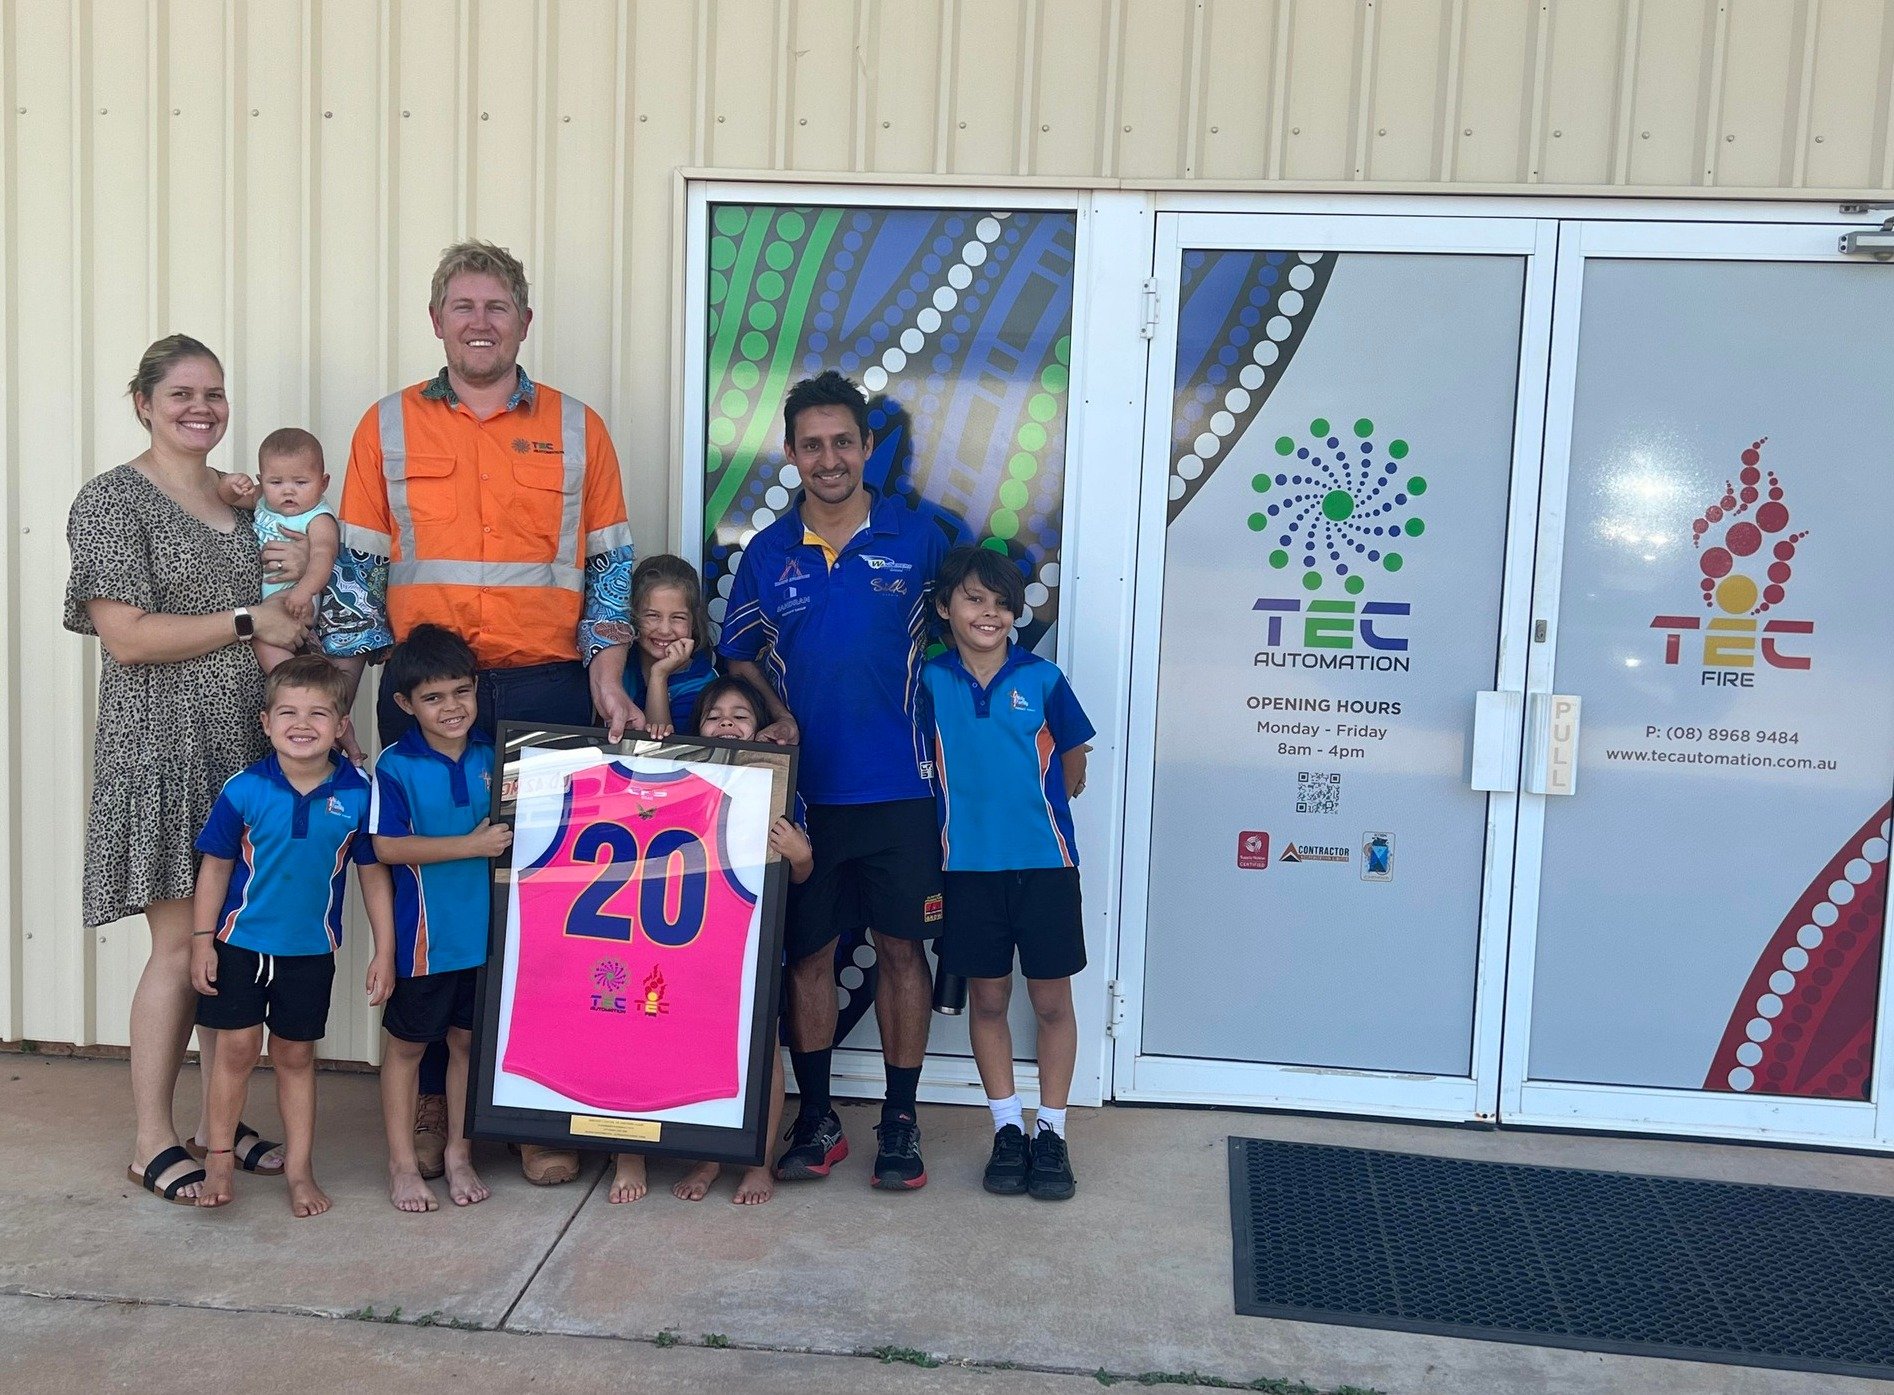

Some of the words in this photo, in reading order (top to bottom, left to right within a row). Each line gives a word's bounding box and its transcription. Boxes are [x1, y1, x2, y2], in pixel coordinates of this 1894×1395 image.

[1252, 598, 1411, 651] TEC
[1650, 615, 1814, 670] TEC
[1253, 652, 1410, 672] AUTOMATION
[1701, 671, 1755, 687] FIRE
[1246, 696, 1330, 713] OPENING
[1337, 700, 1402, 715] HOURS
[1257, 721, 1320, 738] Monday
[1337, 724, 1387, 740] Friday
[1646, 725, 1661, 738] P:
[1666, 726, 1703, 742] (08)
[1708, 728, 1751, 742] 8968
[1756, 730, 1800, 744] 9484
[1277, 742, 1312, 756] 8am
[1328, 745, 1365, 760] 4pm
[1552, 701, 1572, 787] PULL
[1606, 750, 1838, 770] www.tecautomation.com.au
[1298, 845, 1350, 856] CONTRACTOR
[563, 820, 709, 949] 20
[634, 1000, 670, 1014] TEC
